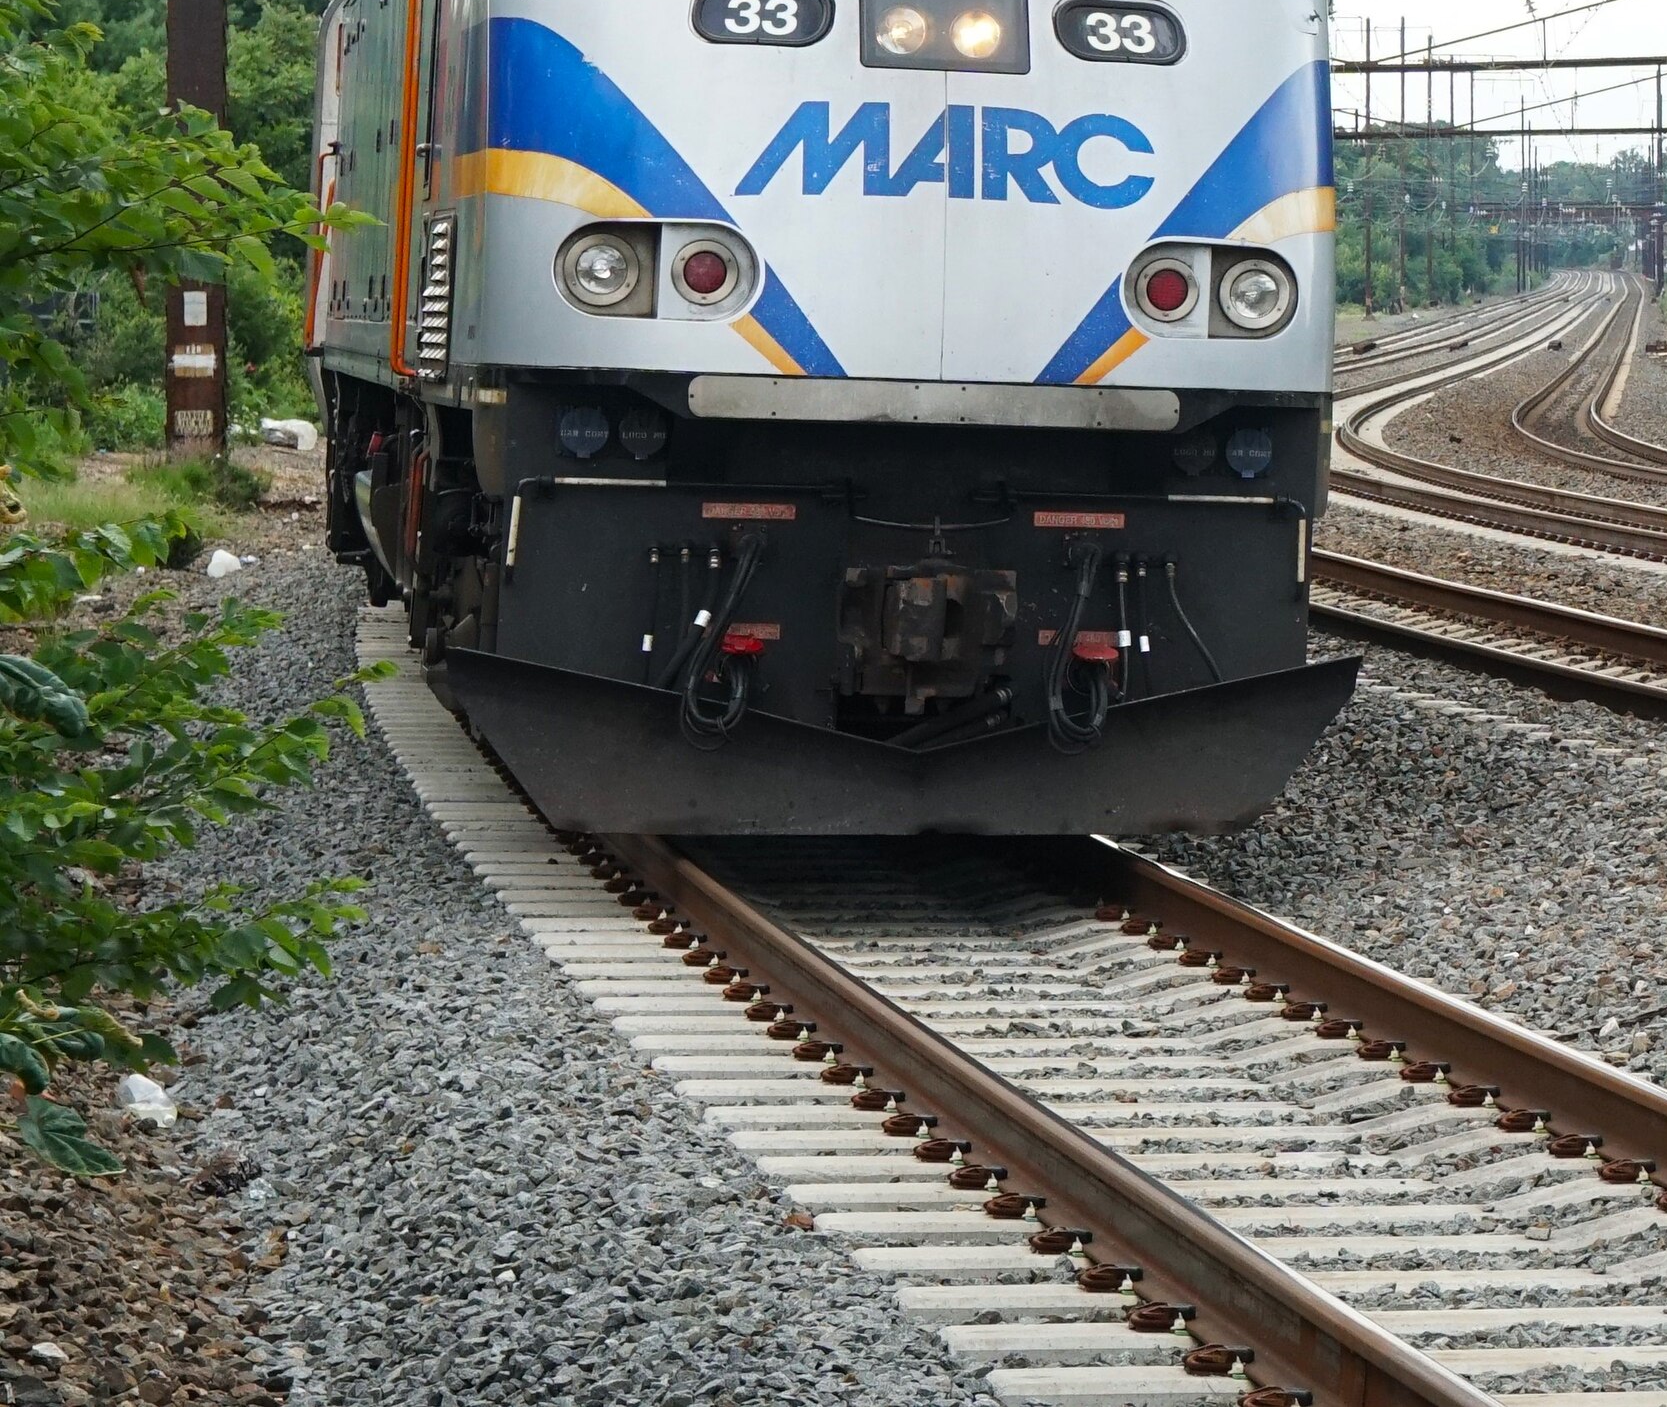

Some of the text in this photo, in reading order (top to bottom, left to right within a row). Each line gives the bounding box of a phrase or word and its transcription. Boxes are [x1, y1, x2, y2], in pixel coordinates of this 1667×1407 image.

[1086, 12, 1156, 54] 33
[734, 101, 1155, 210] MARC
[1040, 515, 1078, 525] DANGER
